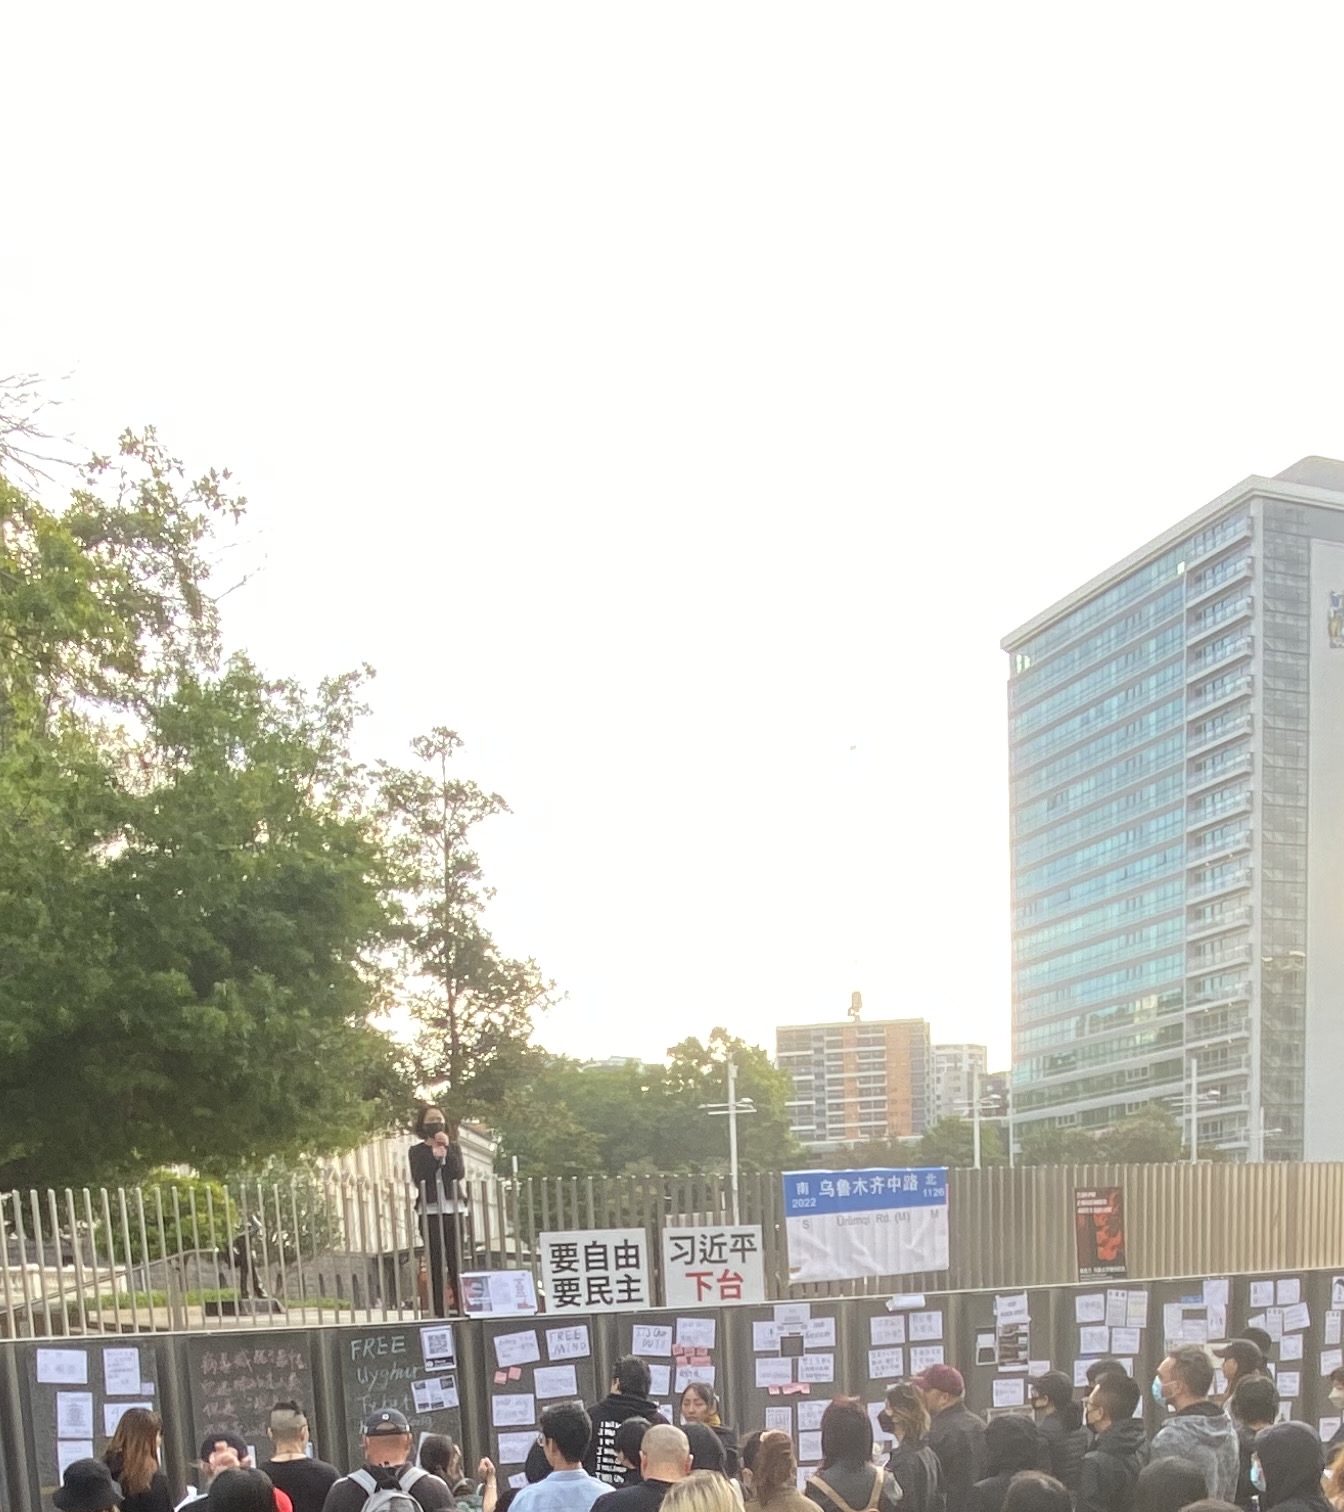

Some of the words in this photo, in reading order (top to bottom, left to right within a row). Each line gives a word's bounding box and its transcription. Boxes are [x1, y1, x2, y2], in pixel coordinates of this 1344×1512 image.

[796, 1181, 809, 1195] 南
[818, 1173, 918, 1198] 乌鲁木齐中路
[925, 1173, 937, 1186] 北
[792, 1197, 817, 1208] 2022
[549, 1238, 641, 1274] 要自由
[669, 1233, 758, 1266] 习近平
[552, 1274, 644, 1308] 要民主
[685, 1268, 744, 1302] 下台
[350, 1335, 407, 1361] FREE
